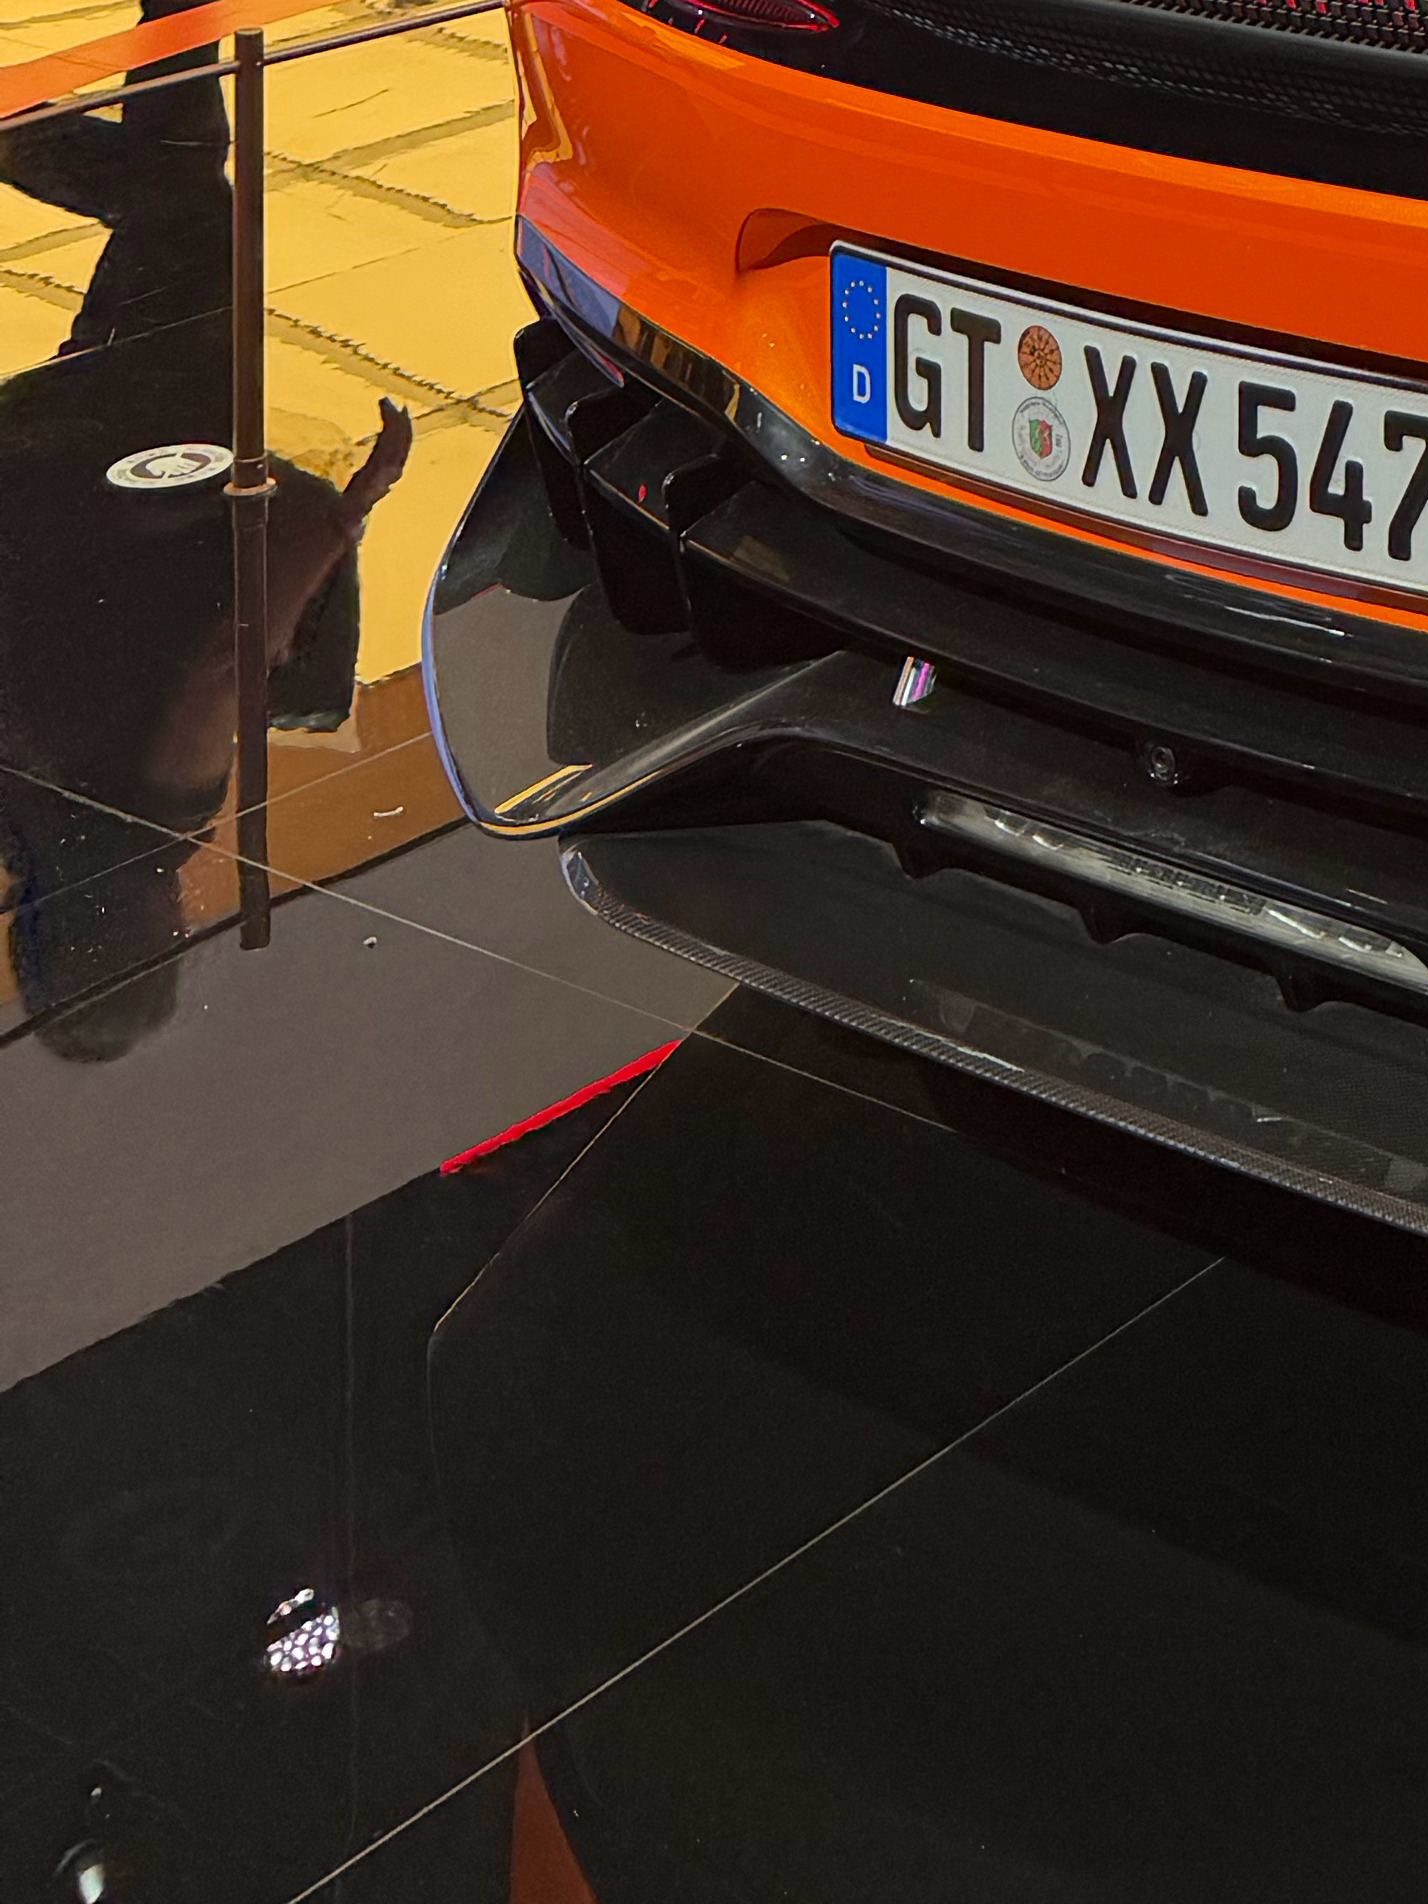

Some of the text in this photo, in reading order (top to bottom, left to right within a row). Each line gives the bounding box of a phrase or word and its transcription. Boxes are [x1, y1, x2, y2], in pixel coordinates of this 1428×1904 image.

[852, 364, 871, 404] D
[893, 293, 1002, 454] GT
[1081, 344, 1209, 517] XX
